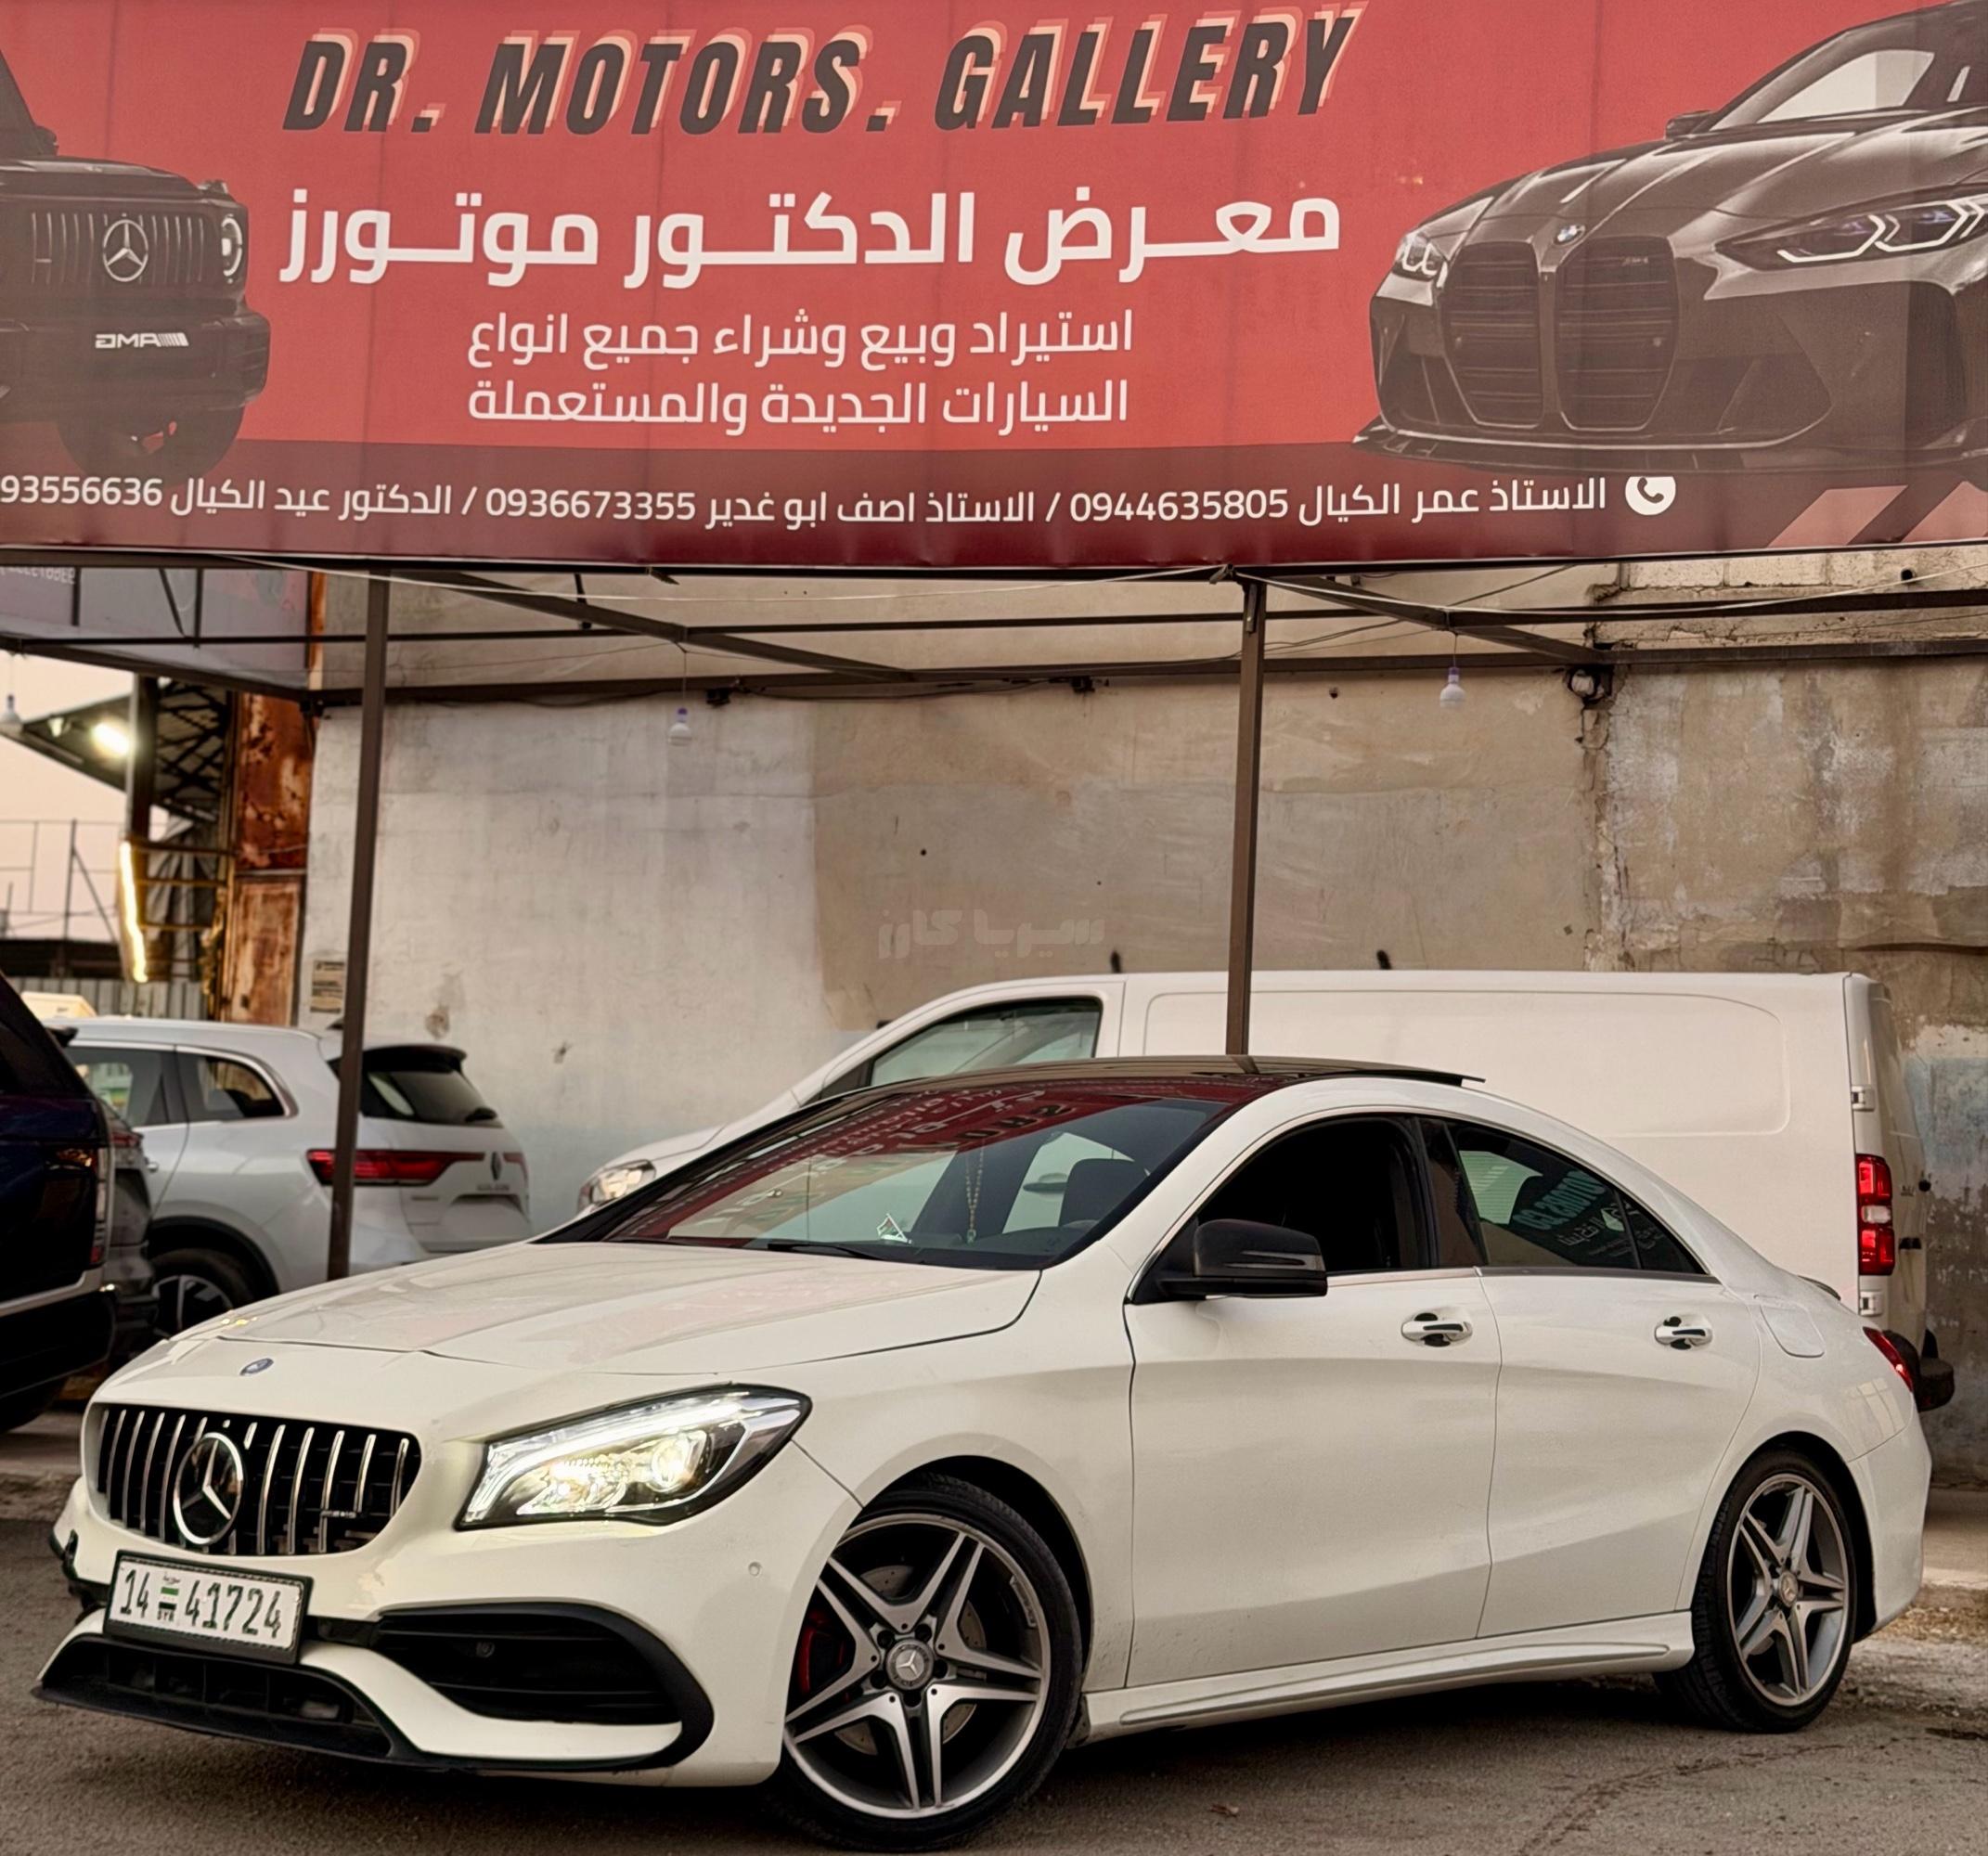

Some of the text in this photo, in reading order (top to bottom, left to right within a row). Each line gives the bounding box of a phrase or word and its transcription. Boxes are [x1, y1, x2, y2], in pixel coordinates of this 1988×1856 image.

[282, 4, 1366, 135] DR. MOTORS. GALLERY
[279, 186, 1340, 290] معرض الدكتور موتورز
[468, 308, 1132, 371] استيراد وبيع وشراء جميع انواع
[469, 380, 1128, 436] السيارات الجديدة والمستعملة
[170, 478, 265, 516] الكيال
[274, 488, 329, 517] عيد
[338, 483, 452, 522] الدكتور
[485, 488, 696, 521] 0936673355
[705, 492, 775, 530] غدير
[784, 492, 827, 530] ابو
[837, 492, 914, 522] اصف
[925, 491, 1034, 522] الاستاذ
[1070, 489, 1288, 522] 0944635805
[1298, 483, 1400, 526] الكيال
[1412, 489, 1479, 523] عمر
[1489, 477, 1606, 511] الاستاذ
[120, 1568, 281, 1639] 14 41724
